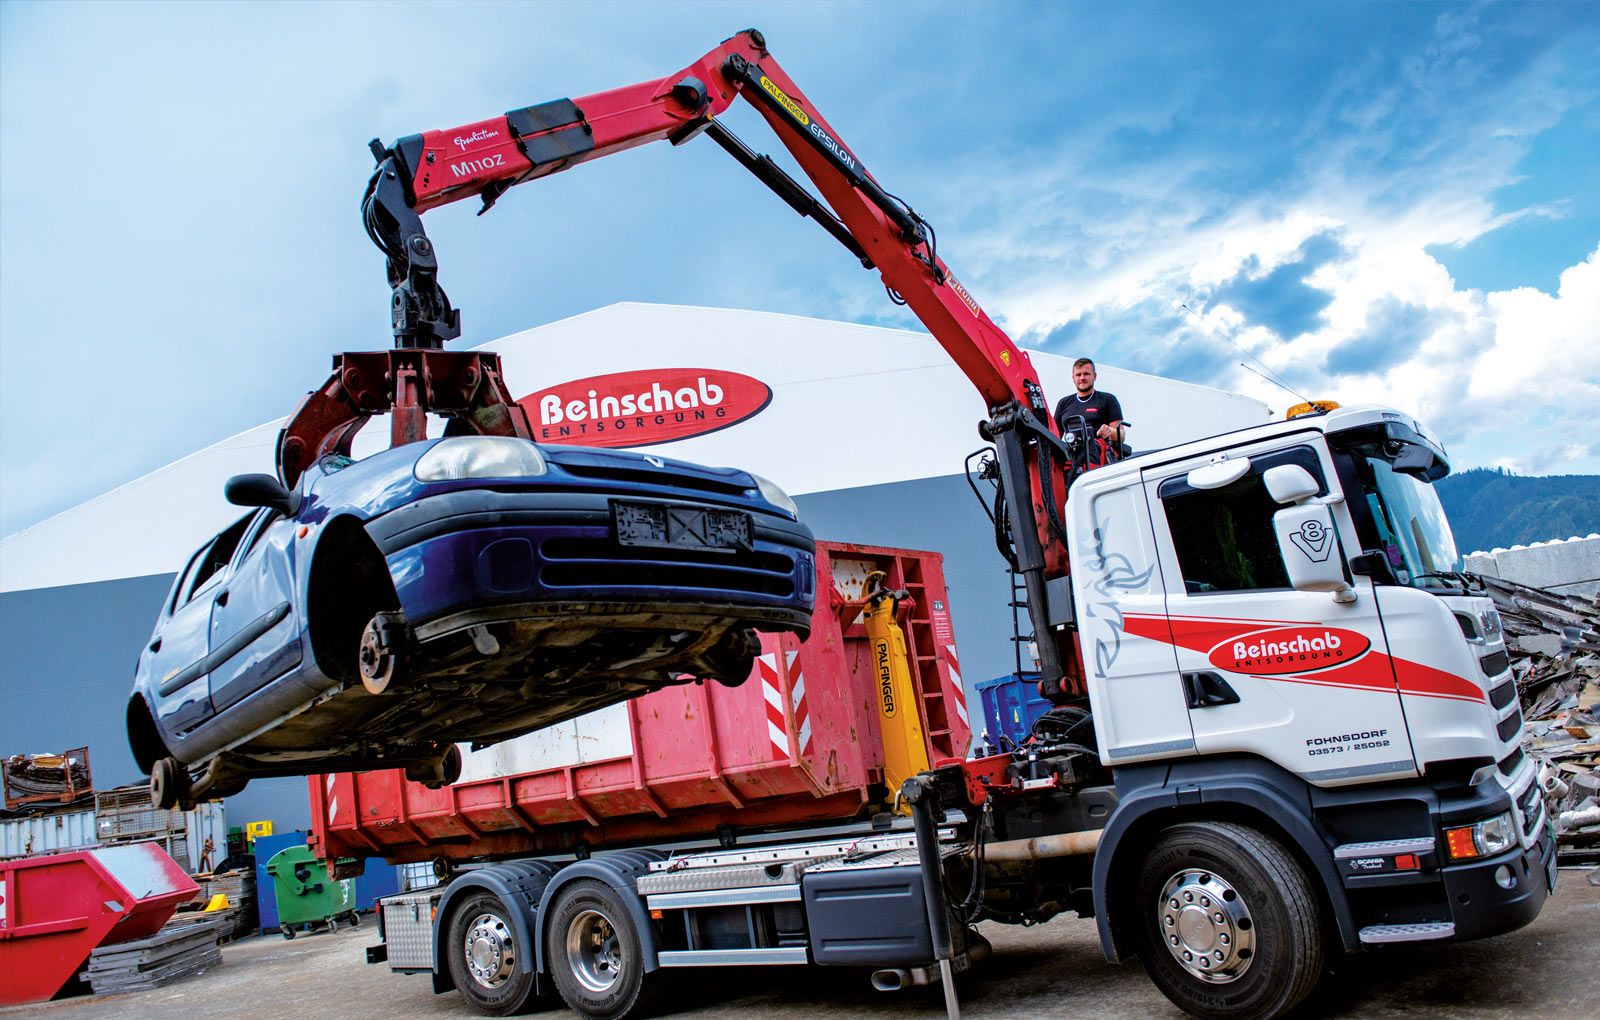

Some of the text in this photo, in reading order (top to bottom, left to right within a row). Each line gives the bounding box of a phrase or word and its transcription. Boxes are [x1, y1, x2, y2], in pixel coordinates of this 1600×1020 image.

[763, 79, 856, 170] PALFINGER EPSILON
[453, 129, 499, 151] Epsolution
[450, 153, 506, 178] M110Z
[539, 376, 724, 425] Beinschab
[542, 407, 726, 438] ENTSORGUNG
[1233, 631, 1341, 660] Beinschab
[1235, 650, 1344, 668] ENTSORGUNG
[877, 643, 894, 713] PALFINGER
[1306, 729, 1388, 747] FOHNSDORF
[1308, 746, 1344, 756] 03573
[1353, 740, 1391, 751] 25052
[1357, 857, 1386, 865] SCANIA
